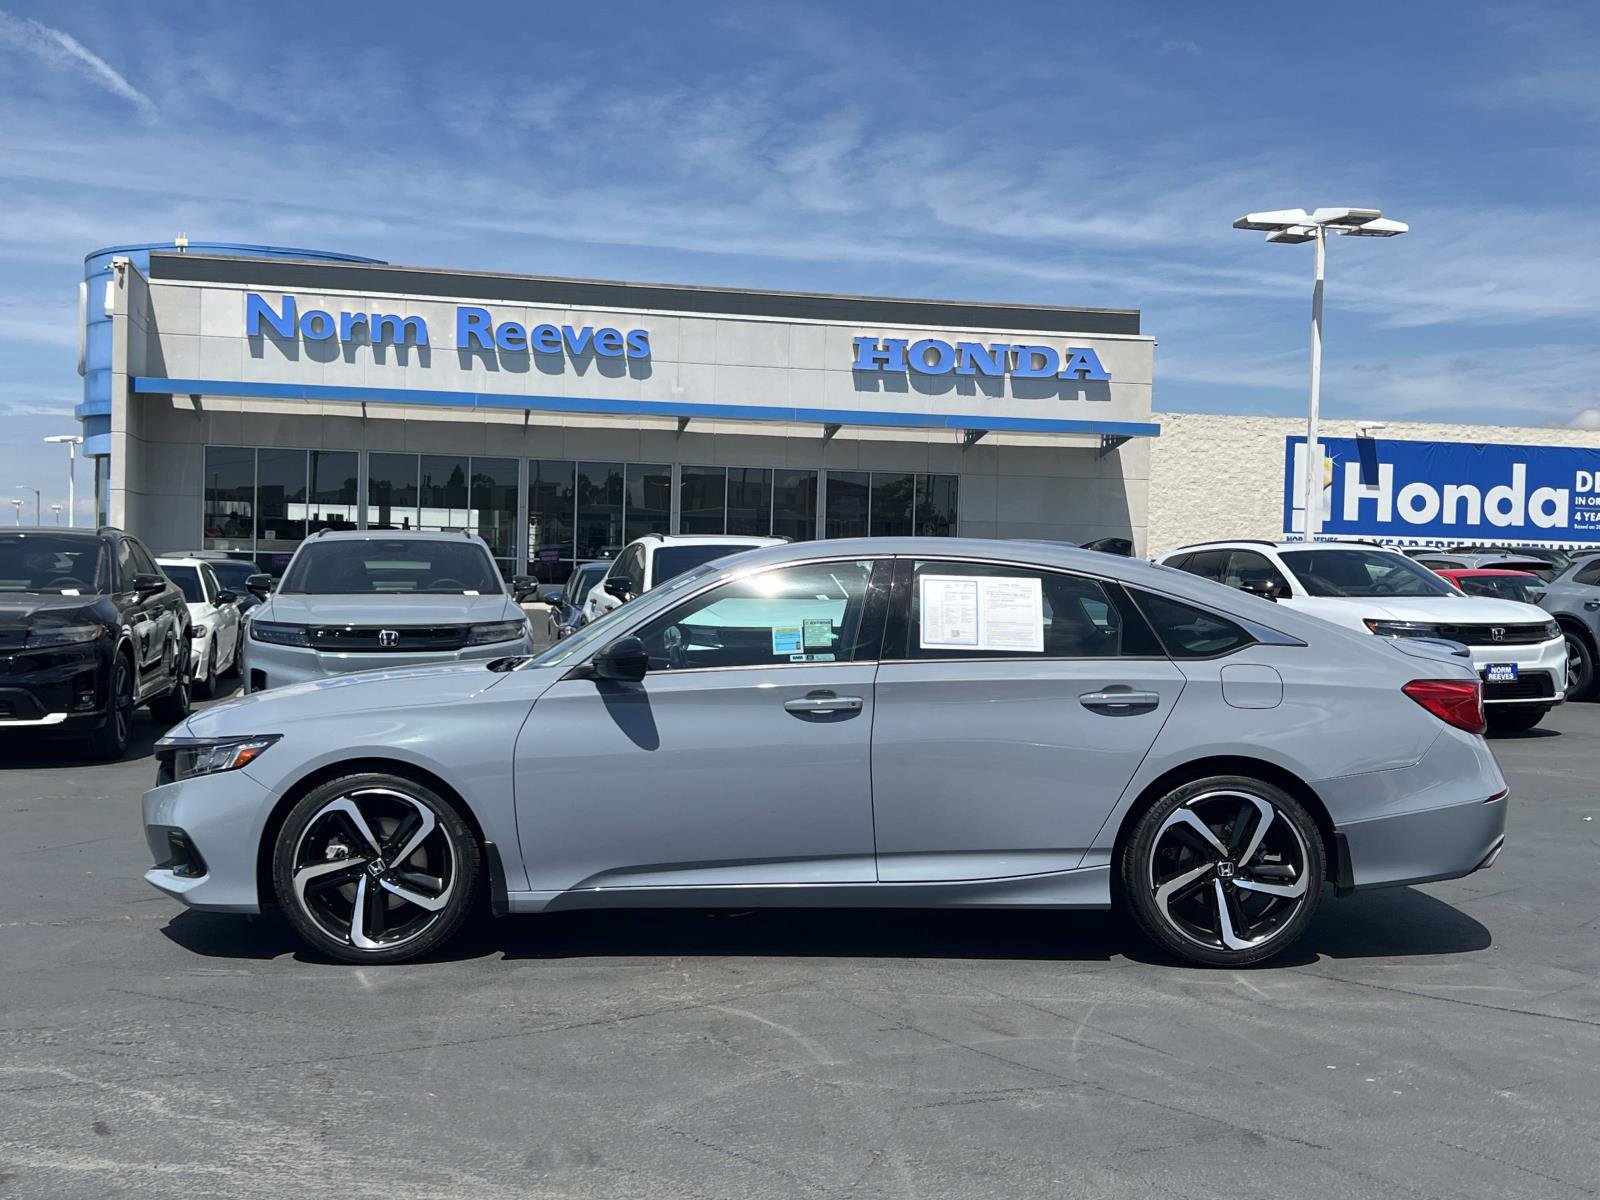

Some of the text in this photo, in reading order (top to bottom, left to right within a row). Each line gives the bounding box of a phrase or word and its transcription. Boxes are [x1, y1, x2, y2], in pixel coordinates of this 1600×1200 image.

[246, 293, 651, 358] Norm Reeves
[852, 336, 1112, 381] HONDA
[1343, 462, 1569, 529] Honda
[1574, 511, 1581, 521] 4
[1575, 496, 1586, 505] IN
